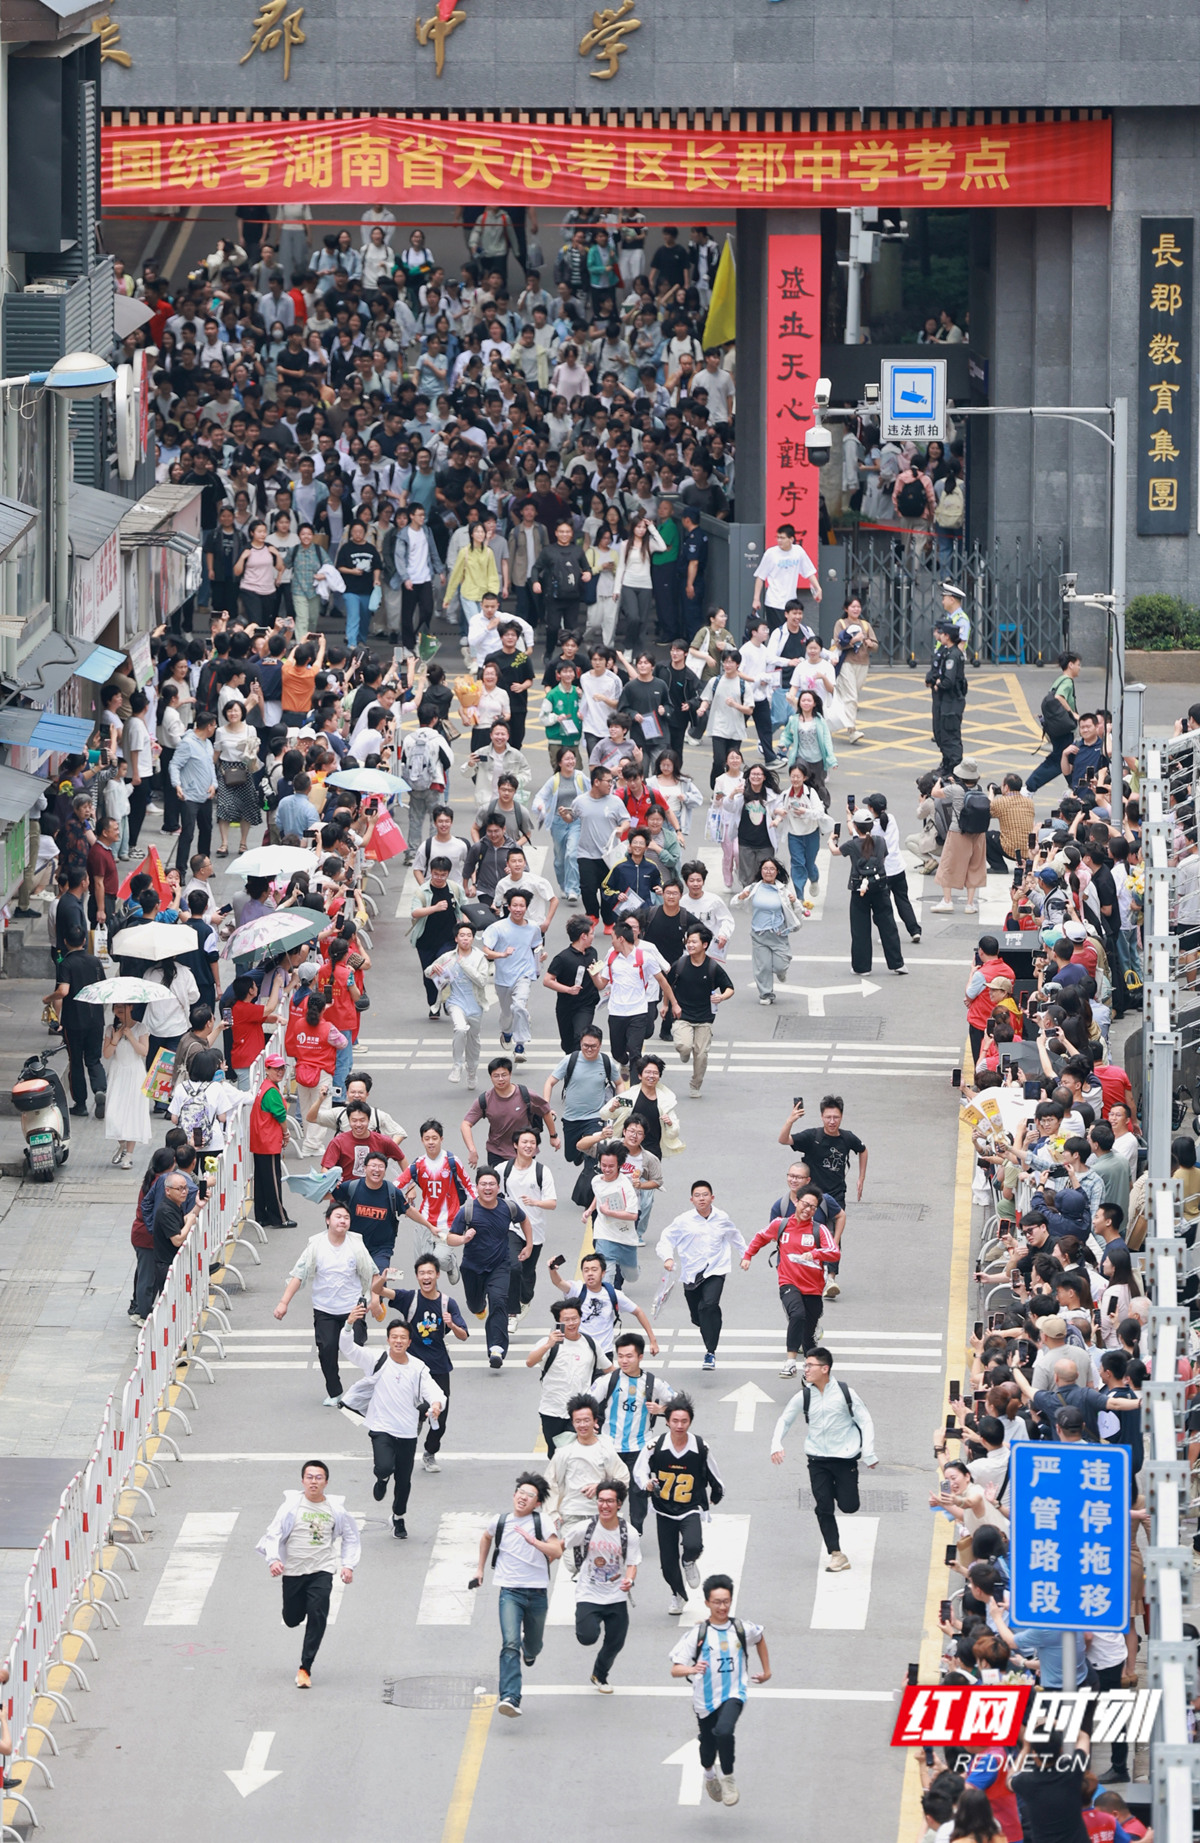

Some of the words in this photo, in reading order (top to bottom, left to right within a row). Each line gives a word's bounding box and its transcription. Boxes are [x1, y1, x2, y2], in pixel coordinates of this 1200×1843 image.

[101, 135, 1010, 192] 国统考湖南省天心考区长郡中学考点
[887, 424, 939, 436] 违法抓拍
[427, 1181, 442, 1198] T
[357, 1205, 387, 1219] MAFTY
[623, 1399, 637, 1412] 66
[658, 1470, 694, 1503] 72
[1029, 1456, 1061, 1613] 严管路段
[1079, 1459, 1112, 1617] 违停拖移
[717, 1657, 735, 1673] 23
